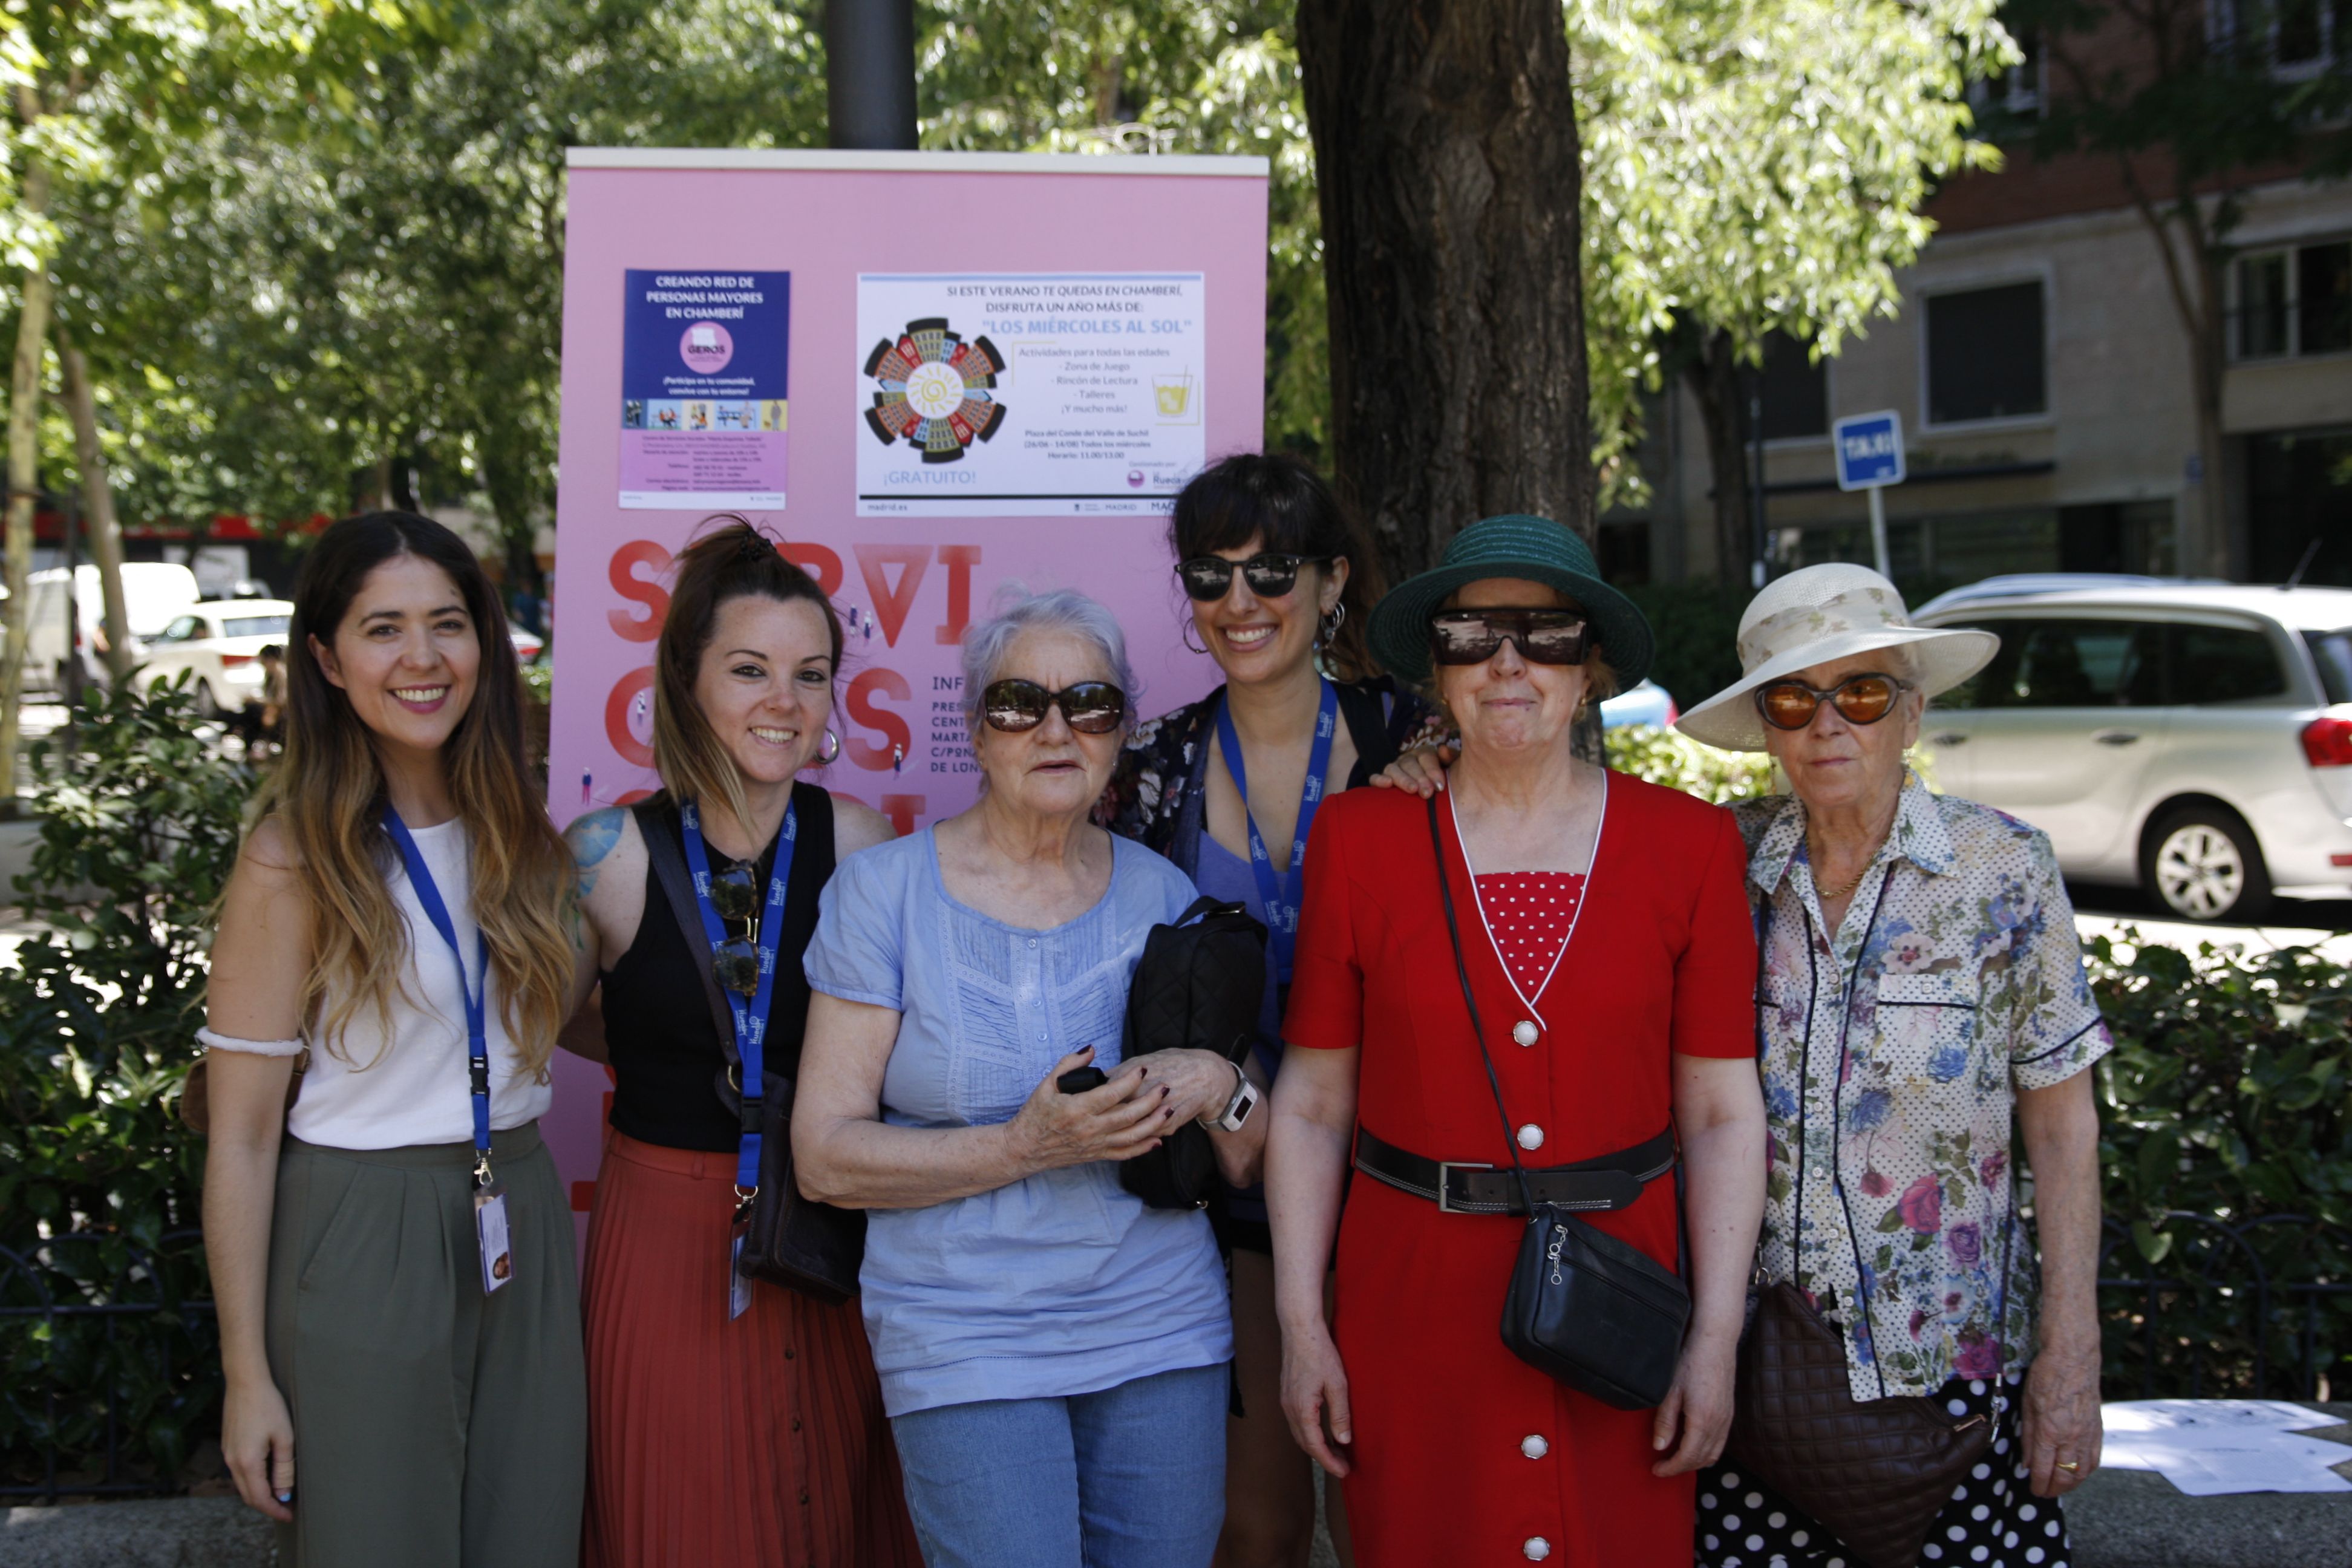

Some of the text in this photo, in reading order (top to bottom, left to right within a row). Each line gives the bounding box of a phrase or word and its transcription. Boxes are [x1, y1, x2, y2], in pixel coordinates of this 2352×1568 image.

[655, 275, 755, 289] CREANDO RED DE
[646, 290, 763, 304] PERSONAS MAYORES
[947, 286, 956, 296] SI
[960, 286, 986, 296] ESTE
[990, 286, 1039, 296] VERANO
[1043, 286, 1054, 296] TE
[1057, 286, 1102, 297] QUEDAS
[1105, 286, 1119, 296] EN
[986, 300, 1143, 313] DISFRUTA UN AÑO MÁS DE:
[665, 307, 682, 318] EN
[1028, 315, 1121, 333] MIÉRCOLES
[1126, 319, 1146, 333] AL
[1019, 348, 1170, 359] Actividades para todas las edades
[1065, 362, 1130, 373] Zona de Juego
[1089, 376, 1100, 385] de
[1103, 376, 1138, 385] Lectura
[1079, 390, 1115, 399] Talleres
[1074, 404, 1103, 413] mucho
[884, 471, 976, 486] ¡GRATUITO!
[930, 762, 947, 773] DE
